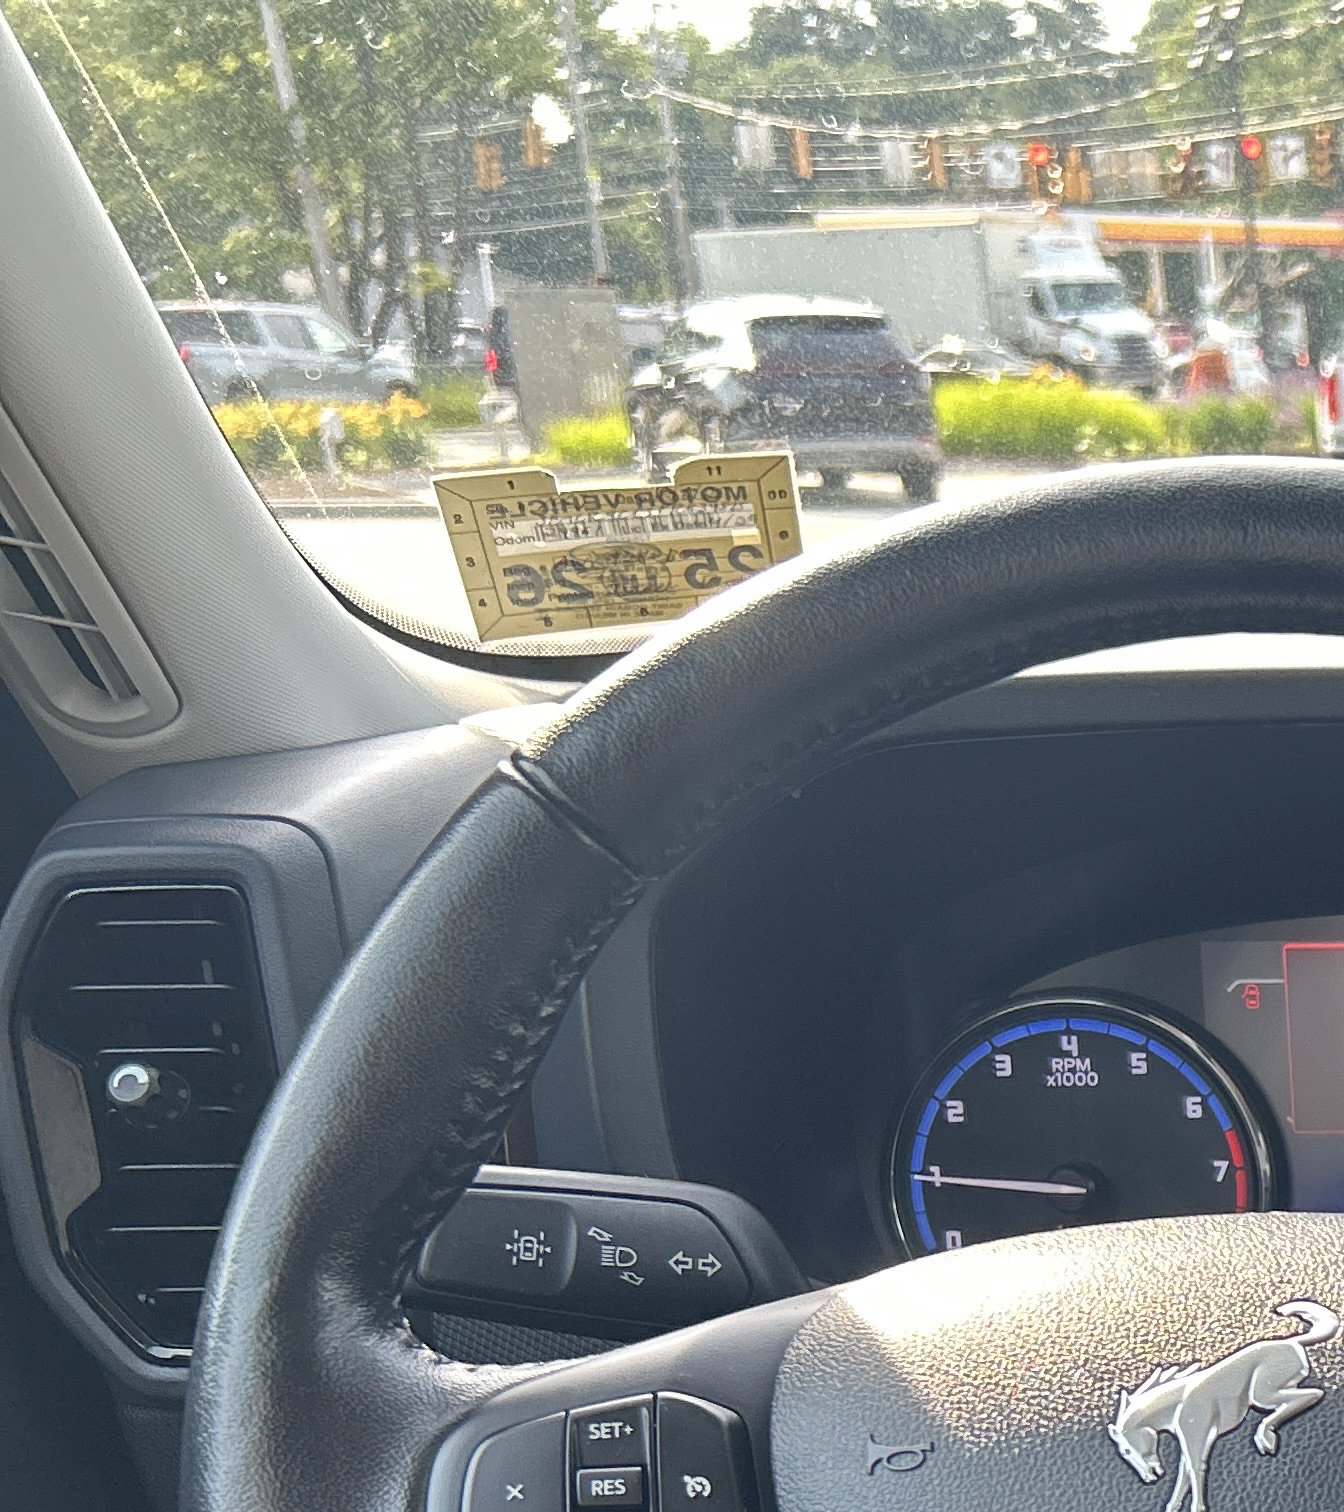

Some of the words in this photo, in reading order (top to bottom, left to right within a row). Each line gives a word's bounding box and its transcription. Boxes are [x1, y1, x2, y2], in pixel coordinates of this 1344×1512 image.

[490, 520, 515, 531] VIN
[1061, 1036, 1078, 1056] 4
[995, 1055, 1011, 1076] 3
[1051, 1058, 1093, 1074] RPM
[1130, 1053, 1147, 1074] 5
[1047, 1071, 1098, 1086] x1000
[946, 1101, 964, 1122] 2
[1186, 1097, 1202, 1118] 6
[1213, 1160, 1229, 1182] 7
[589, 1422, 633, 1439] SET+
[591, 1479, 625, 1495] RES
